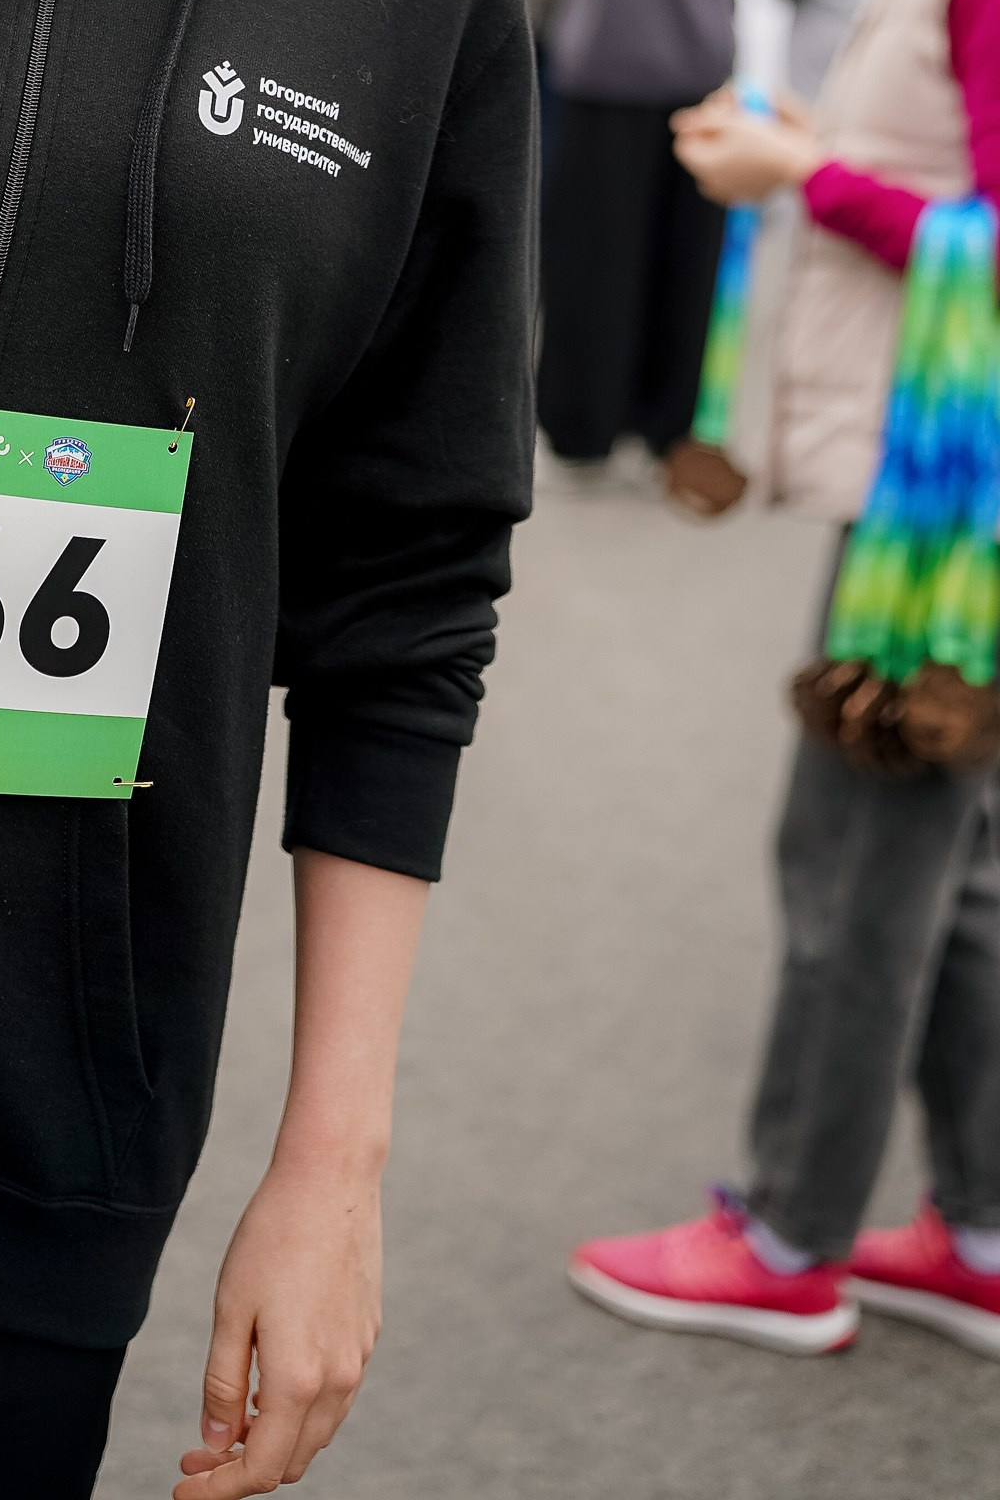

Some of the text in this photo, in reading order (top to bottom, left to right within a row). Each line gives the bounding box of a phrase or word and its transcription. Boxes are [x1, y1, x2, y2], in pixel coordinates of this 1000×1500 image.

[259, 77, 340, 121] Югорский
[252, 127, 342, 178] университет
[256, 103, 372, 169] государственный
